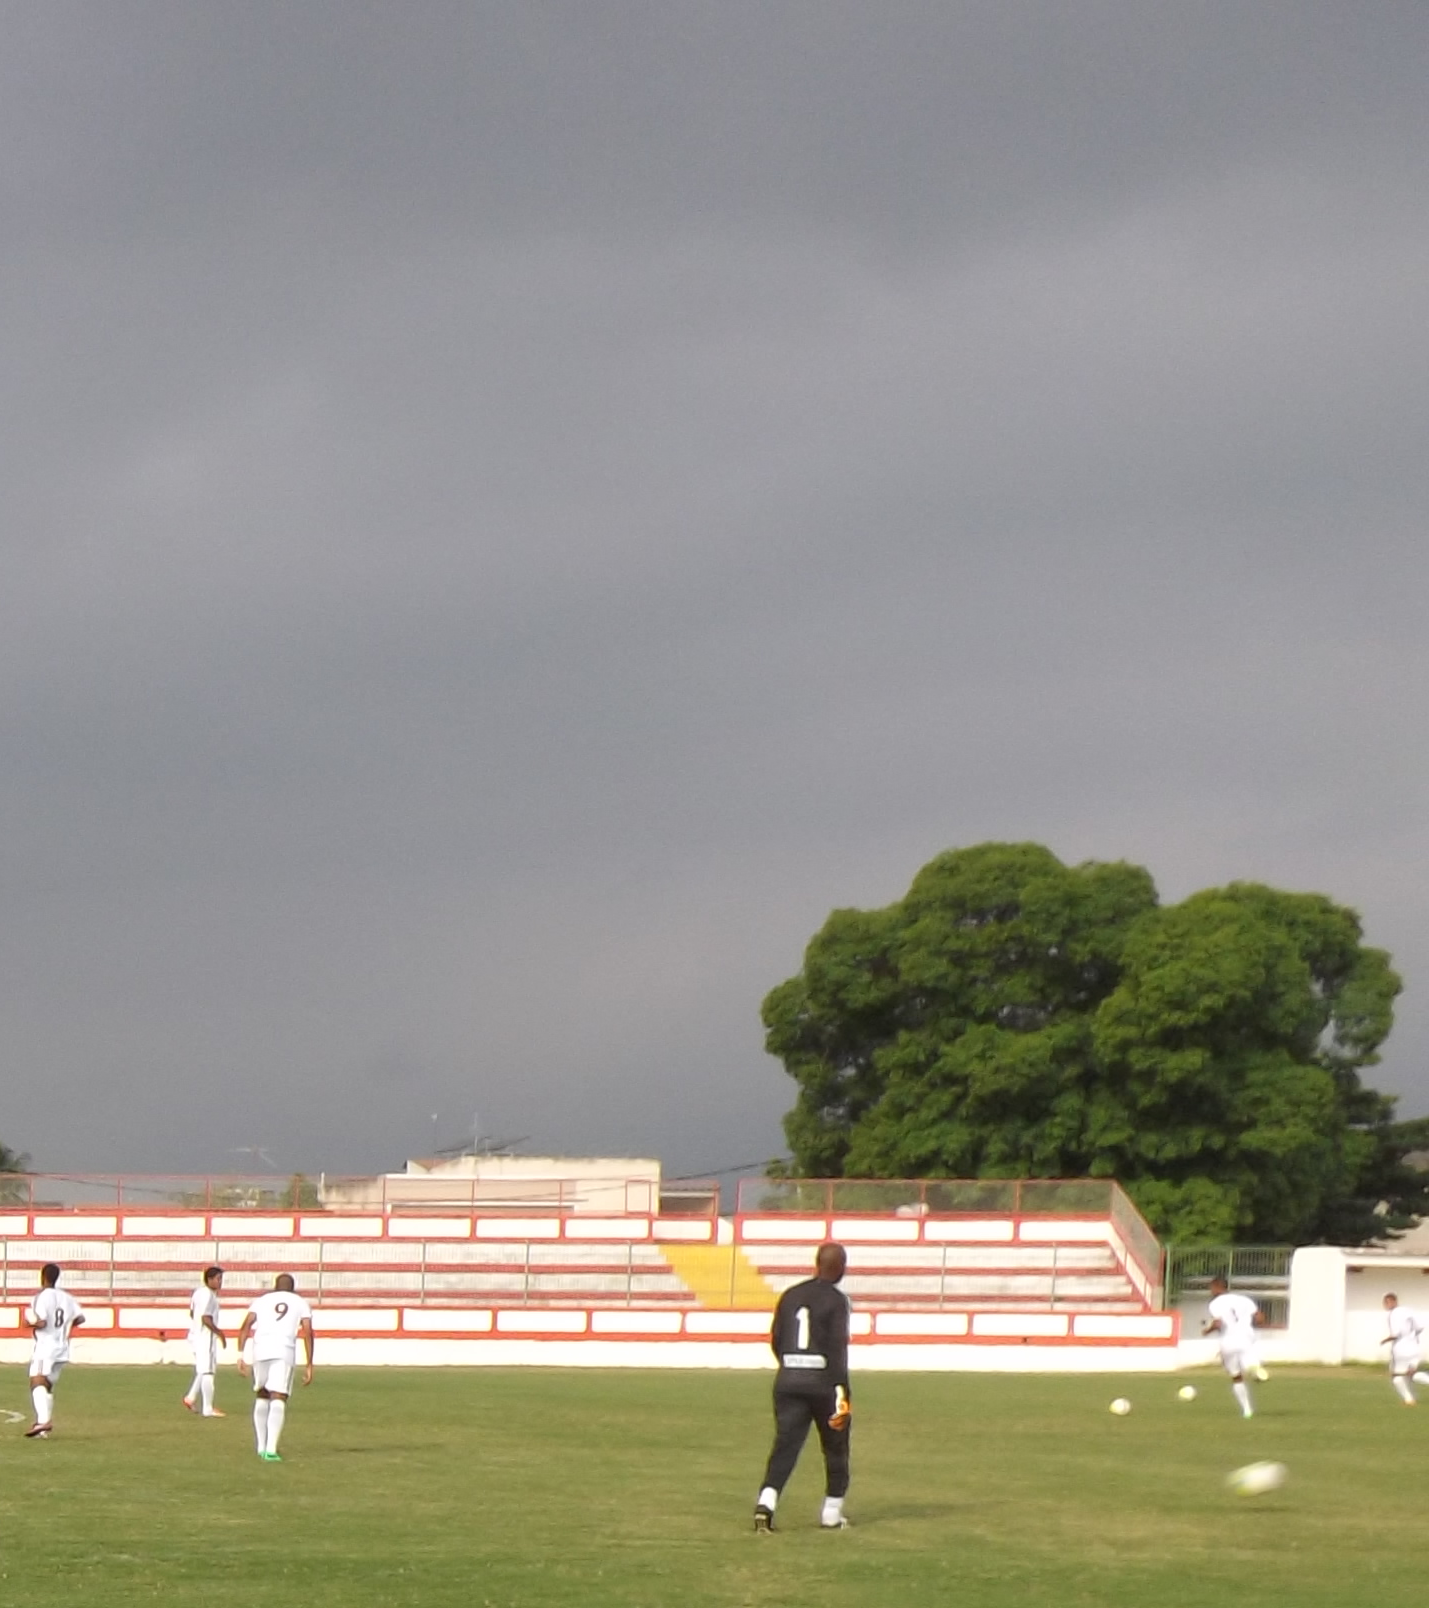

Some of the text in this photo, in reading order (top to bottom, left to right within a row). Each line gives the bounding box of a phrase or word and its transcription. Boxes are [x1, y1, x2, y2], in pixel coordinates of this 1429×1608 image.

[55, 1308, 64, 1328] 8
[275, 1303, 289, 1321] 9
[796, 1307, 809, 1350] 1
